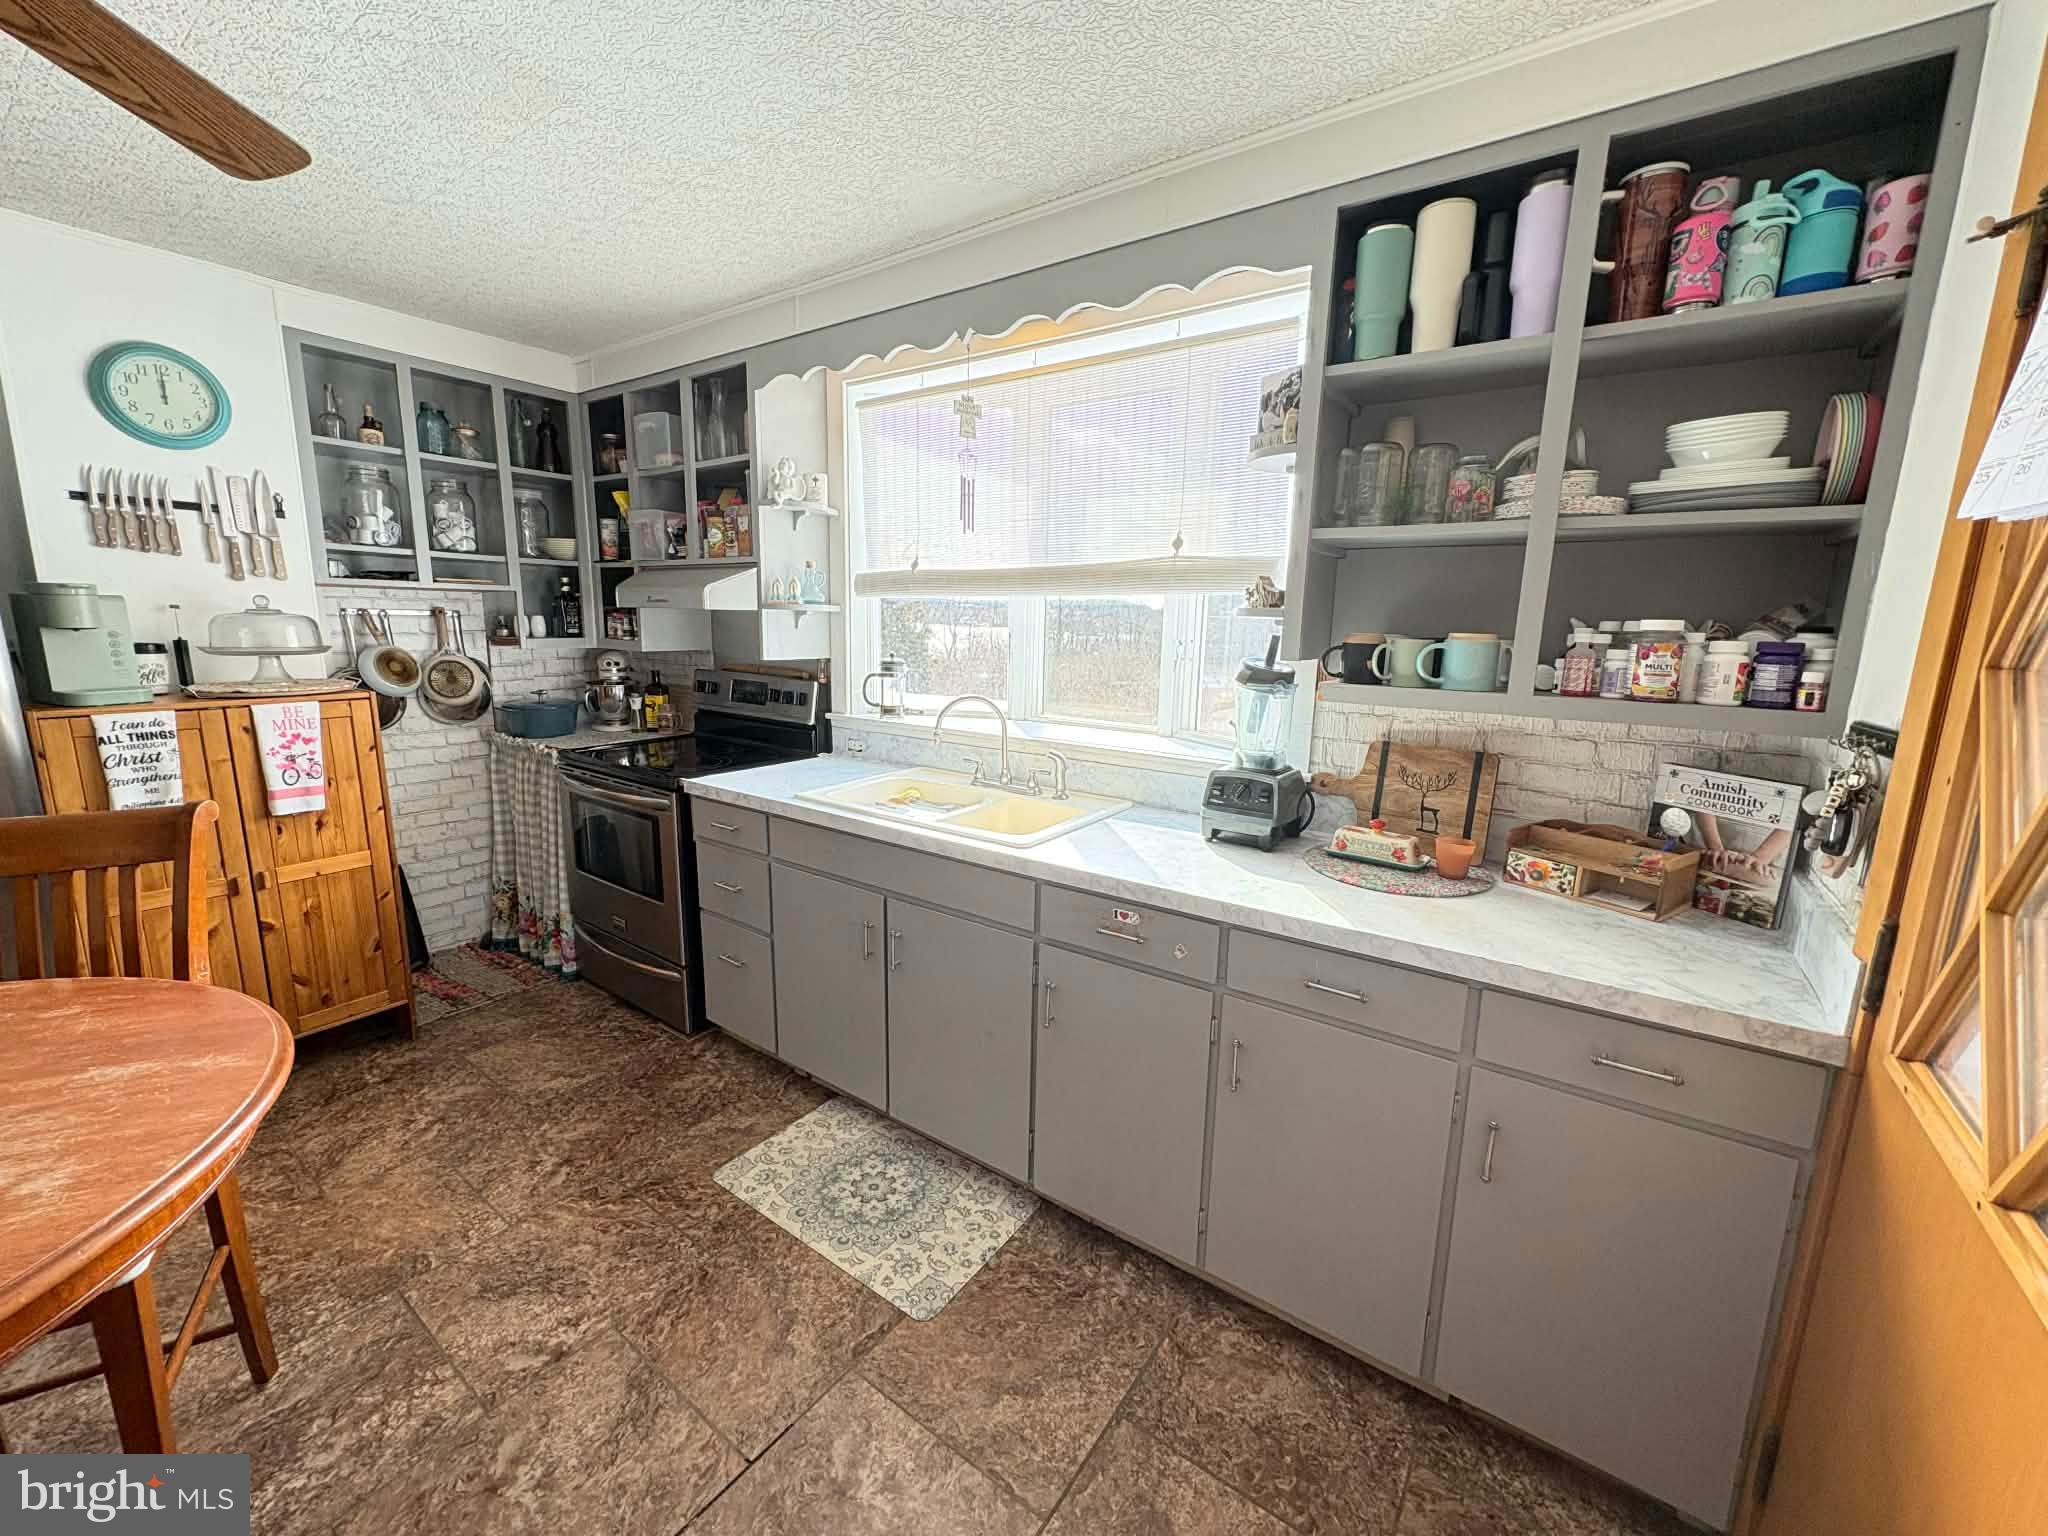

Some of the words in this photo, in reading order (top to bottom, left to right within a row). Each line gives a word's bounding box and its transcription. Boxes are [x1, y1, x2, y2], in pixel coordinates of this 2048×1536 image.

[136, 364, 147, 376] 11
[152, 364, 170, 377] 12
[123, 372, 138, 384] 10
[177, 372, 182, 383] 1
[118, 385, 128, 397] 9
[190, 383, 200, 395] 2
[128, 400, 138, 412] 8
[199, 397, 208, 408] 3
[144, 413, 154, 425] 7
[193, 410, 201, 421] 4
[164, 419, 174, 431] 6
[183, 418, 191, 429] 5
[282, 705, 304, 719] BE
[111, 720, 119, 732] I
[120, 722, 146, 730] can
[149, 718, 165, 728] do
[272, 718, 318, 732] MINE
[98, 733, 123, 746] ALL
[127, 730, 176, 743] THINGS
[116, 741, 168, 752] THROUGH
[103, 751, 164, 770] Christ
[130, 765, 158, 774] WHO
[144, 787, 161, 795] ME
[1700, 778, 1748, 797] Amish
[1680, 783, 1768, 810] Community
[1687, 797, 1754, 817] COOKBOOK
